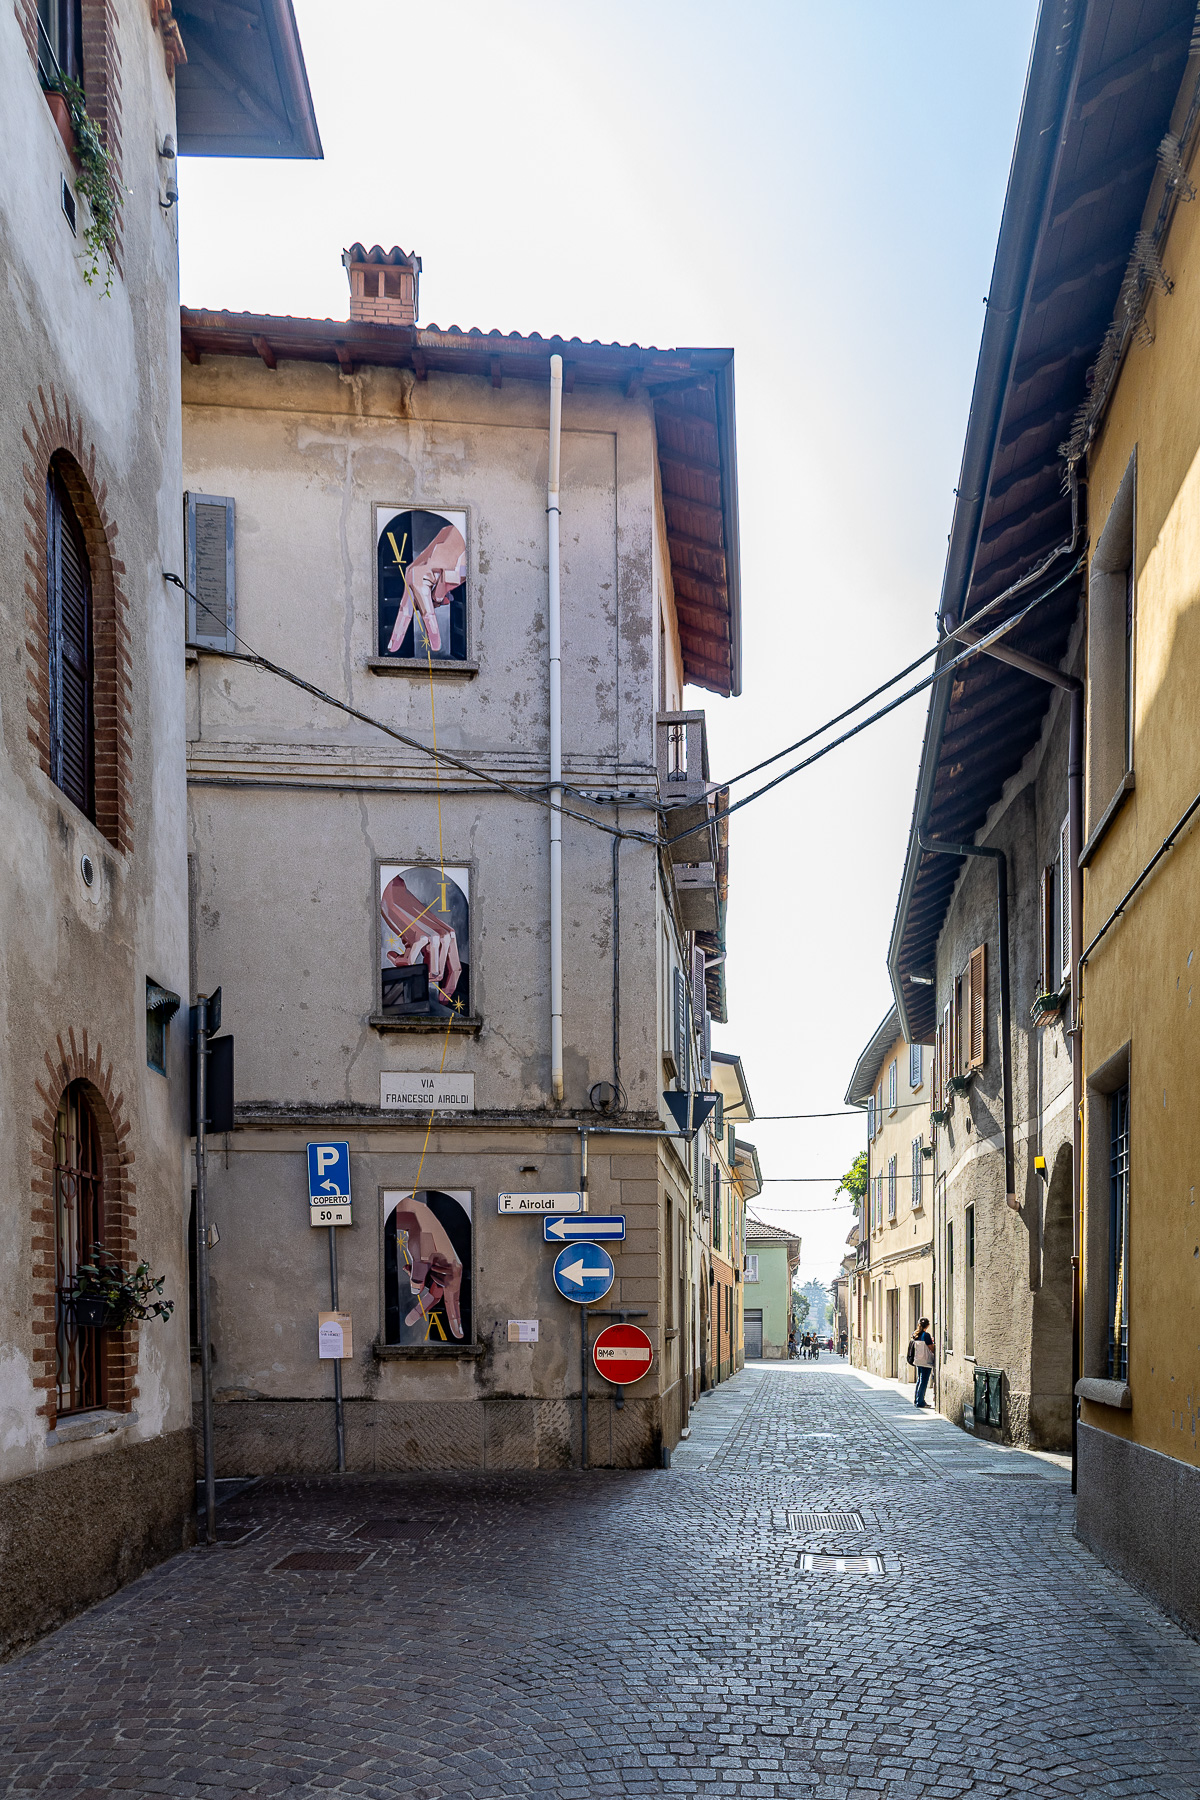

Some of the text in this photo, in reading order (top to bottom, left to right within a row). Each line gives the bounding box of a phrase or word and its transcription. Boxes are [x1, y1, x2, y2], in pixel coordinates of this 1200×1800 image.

[421, 1079, 435, 1089] VIA
[386, 1093, 469, 1104] FRANCESCO AIROLDI
[316, 1146, 340, 1176] P
[313, 1195, 348, 1205] COPERTO
[504, 1199, 555, 1210] F. Airoldi
[320, 1210, 332, 1221] 50
